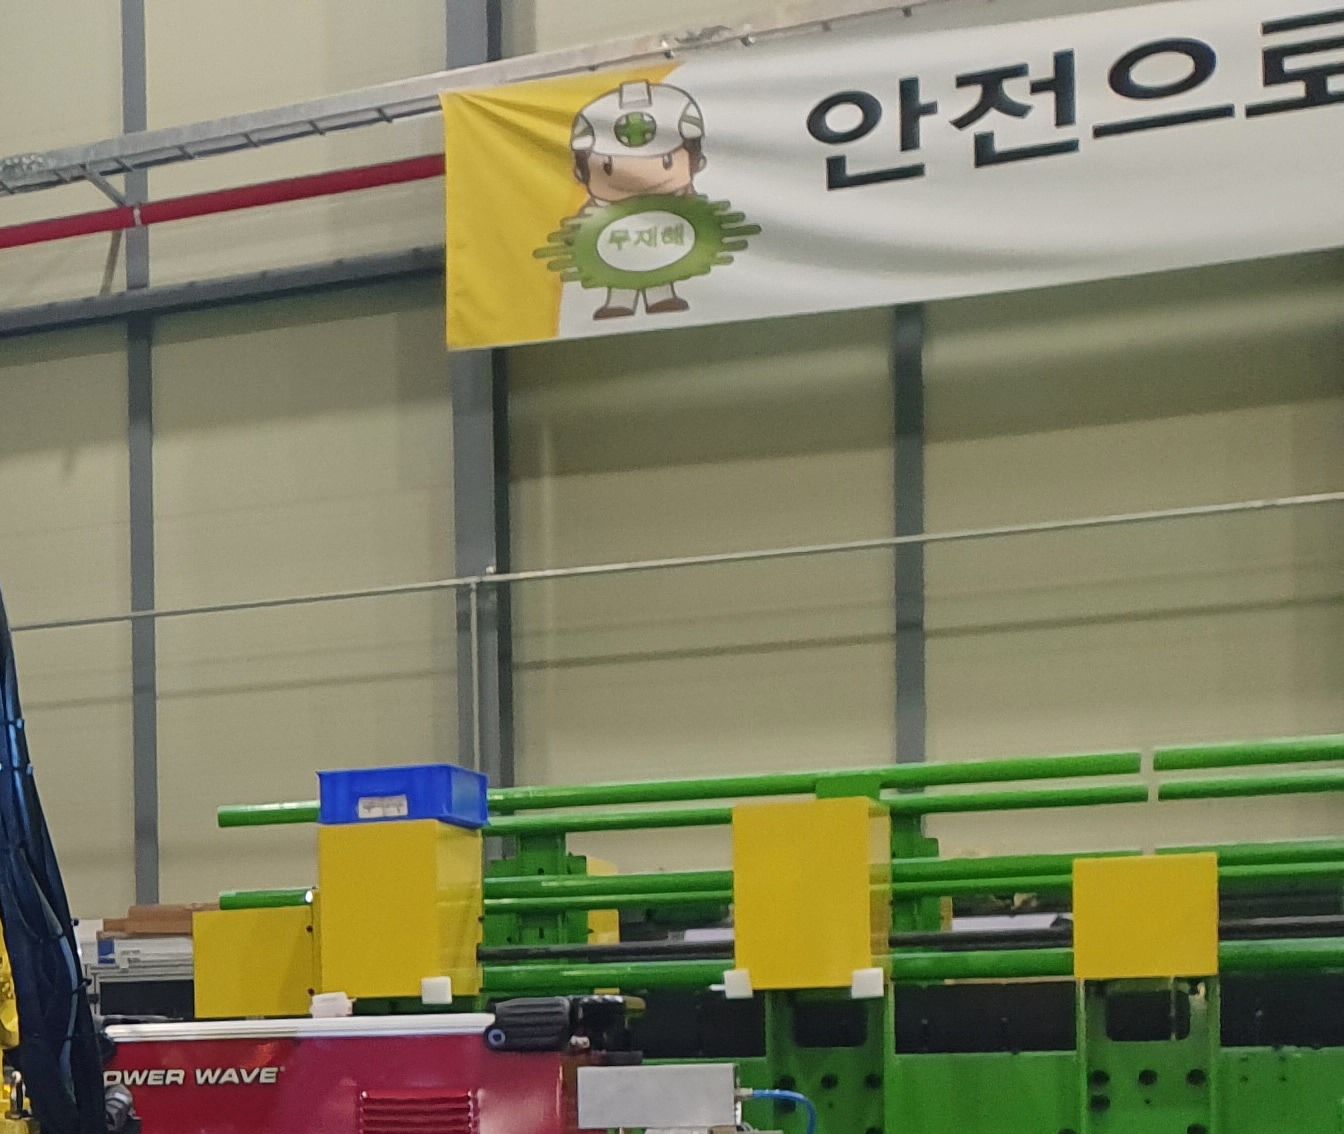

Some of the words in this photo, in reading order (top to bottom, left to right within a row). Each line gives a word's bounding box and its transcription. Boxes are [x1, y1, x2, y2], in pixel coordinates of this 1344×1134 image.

[609, 222, 685, 251] 무재해
[103, 1069, 186, 1087] OWER
[195, 1066, 280, 1085] WAVE
